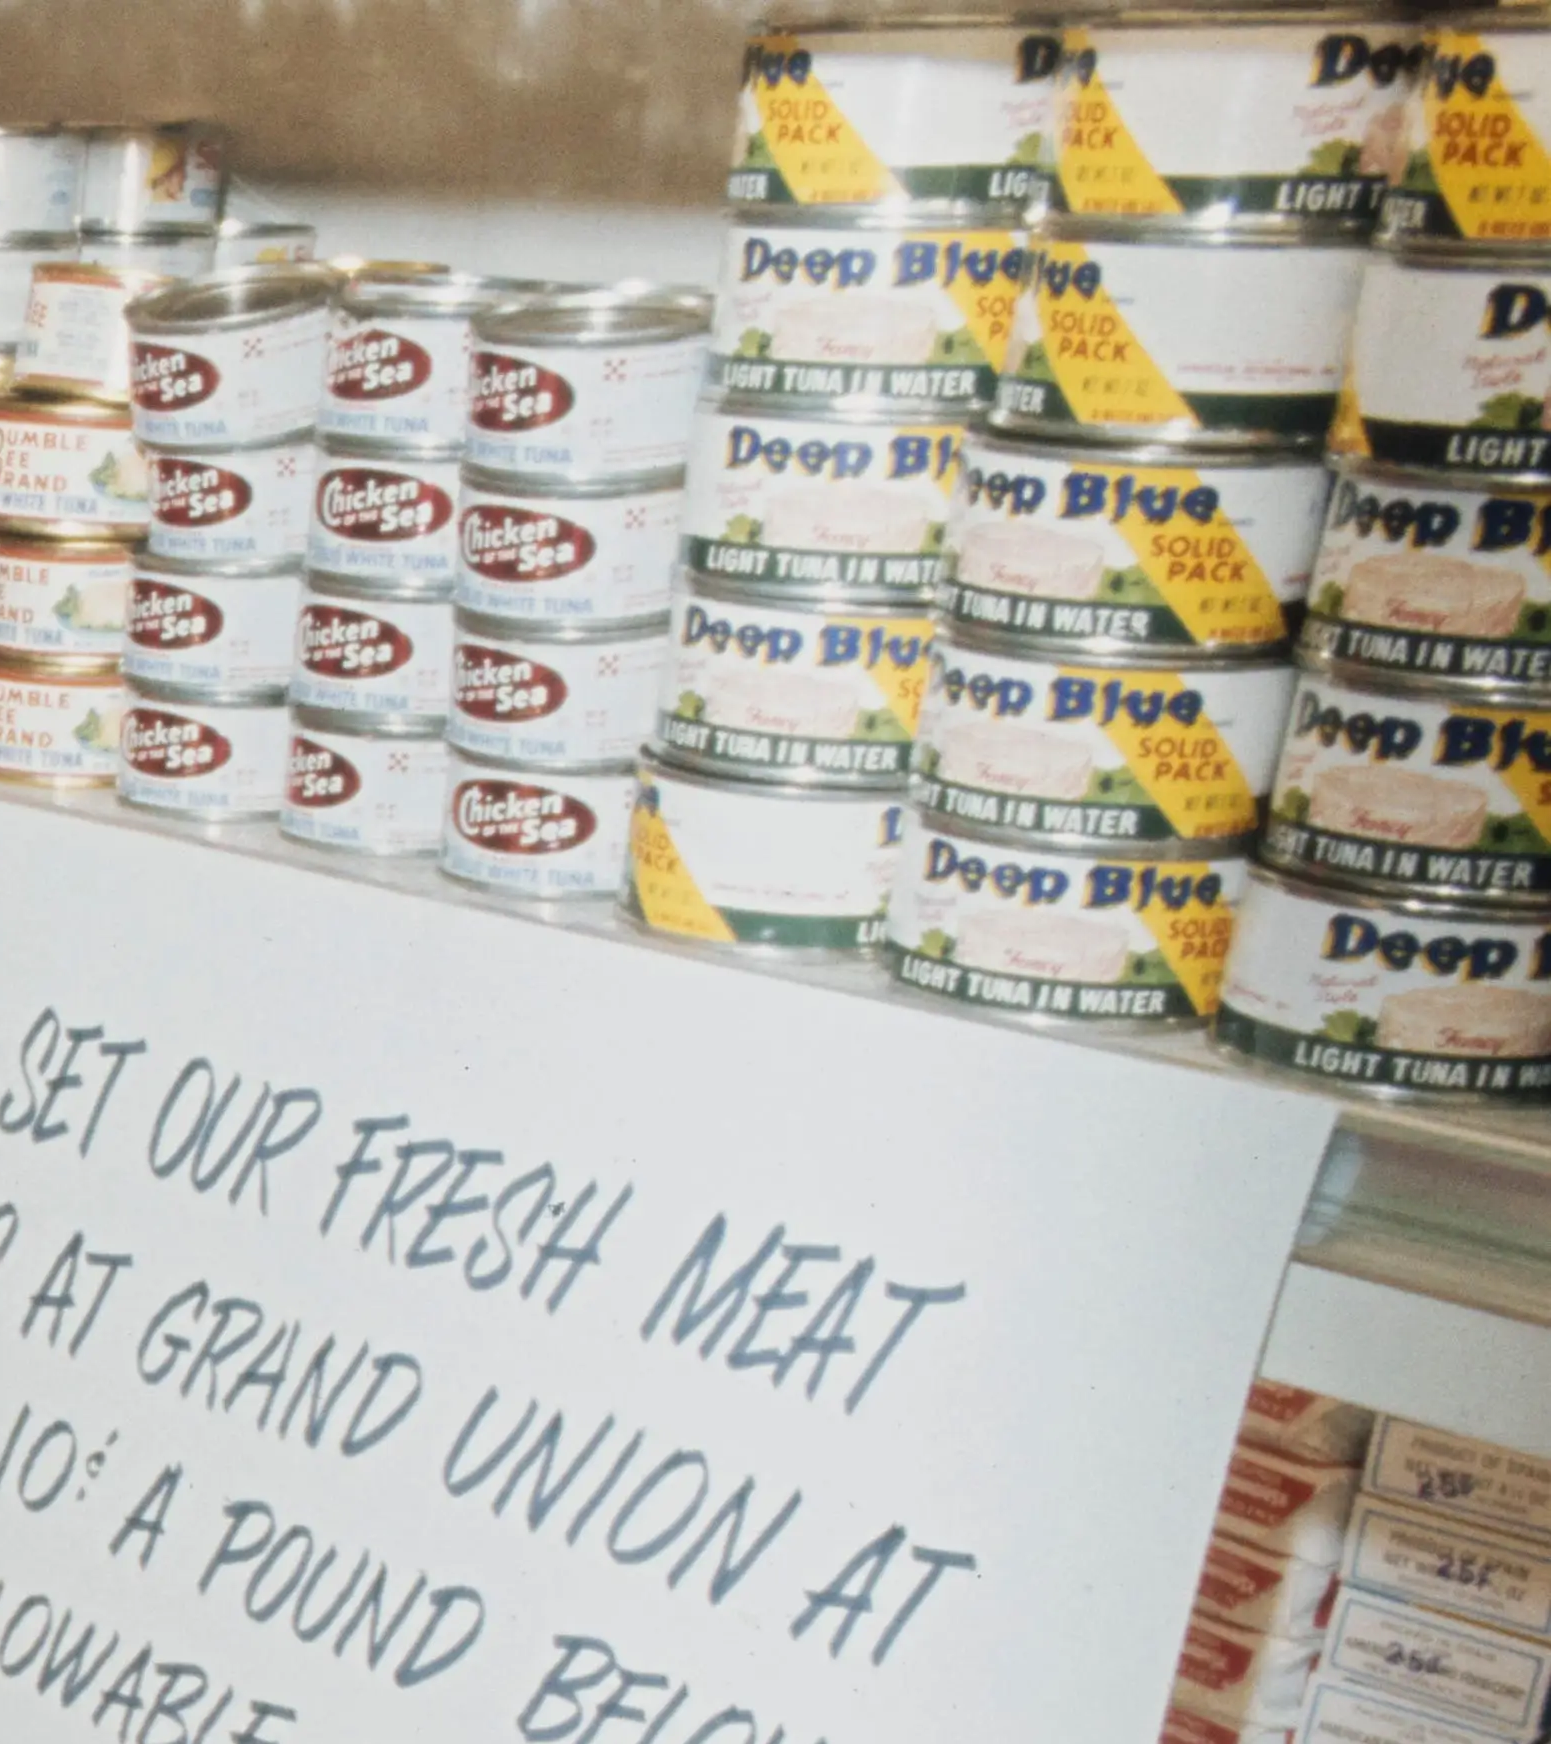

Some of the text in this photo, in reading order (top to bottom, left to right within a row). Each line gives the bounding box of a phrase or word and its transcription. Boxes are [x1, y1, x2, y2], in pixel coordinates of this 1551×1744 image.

[768, 100, 828, 122] SOLID
[1436, 111, 1512, 139] SOLID
[776, 123, 842, 145] PACK
[1442, 140, 1529, 168] PACK
[1275, 181, 1362, 212] LIGHT
[740, 236, 1023, 291] Deep Blue
[1048, 309, 1118, 338] SOLID
[1057, 336, 1130, 363] PACK
[159, 373, 203, 403] Sea
[362, 360, 414, 392] Sea
[722, 363, 977, 399] LIGHT TUNA IN WATER
[502, 391, 552, 422] Sea
[725, 425, 873, 484] Deep
[1447, 433, 1548, 469] LIGHT
[188, 489, 235, 519] Sea
[323, 475, 419, 528] Chicken
[379, 500, 435, 533] Sea
[1059, 471, 1220, 527] Blue
[1329, 478, 1460, 554] Deep
[464, 510, 558, 563] Chicken
[1151, 534, 1237, 560] SOLID
[518, 541, 576, 573] Sea
[706, 545, 770, 576] LIGHT
[777, 552, 840, 580] TUNA
[847, 556, 878, 583] IN
[1167, 560, 1249, 584] PACK
[160, 614, 207, 641] Sea
[961, 588, 1151, 639] TUNA IN WATER
[681, 603, 804, 669] Deep
[1349, 627, 1454, 669] TUNA IN
[342, 642, 394, 670] Sea
[496, 685, 548, 712] Sea
[1046, 675, 1204, 728] Blue
[663, 718, 898, 772] LIGHT TUNA IN WATER
[1295, 690, 1424, 767] Deep
[165, 743, 214, 770] Sea
[1136, 736, 1219, 760] SOLID
[302, 773, 346, 799] Sea
[1153, 760, 1229, 784] PACK
[460, 784, 563, 835] Chicken
[947, 786, 1142, 837] TUNA IN WATER
[519, 817, 577, 846] Sea
[925, 836, 1224, 914] Deep Blue
[1313, 835, 1536, 890] TUNA IN WATER
[1319, 912, 1521, 986] Deep
[900, 953, 1169, 1017] LIGHT TUNA IN WATER
[1293, 1041, 1515, 1090] LIGHT TUNA IN
[148, 1056, 323, 1217] OUR
[319, 1114, 634, 1317] FRESH
[639, 1210, 968, 1416] MEAT
[19, 1231, 135, 1359] AT
[136, 1279, 424, 1457] GRAND
[443, 1385, 804, 1606] UNION
[788, 1521, 978, 1667] AT
[108, 1461, 185, 1571] A
[198, 1499, 487, 1689] POUND
